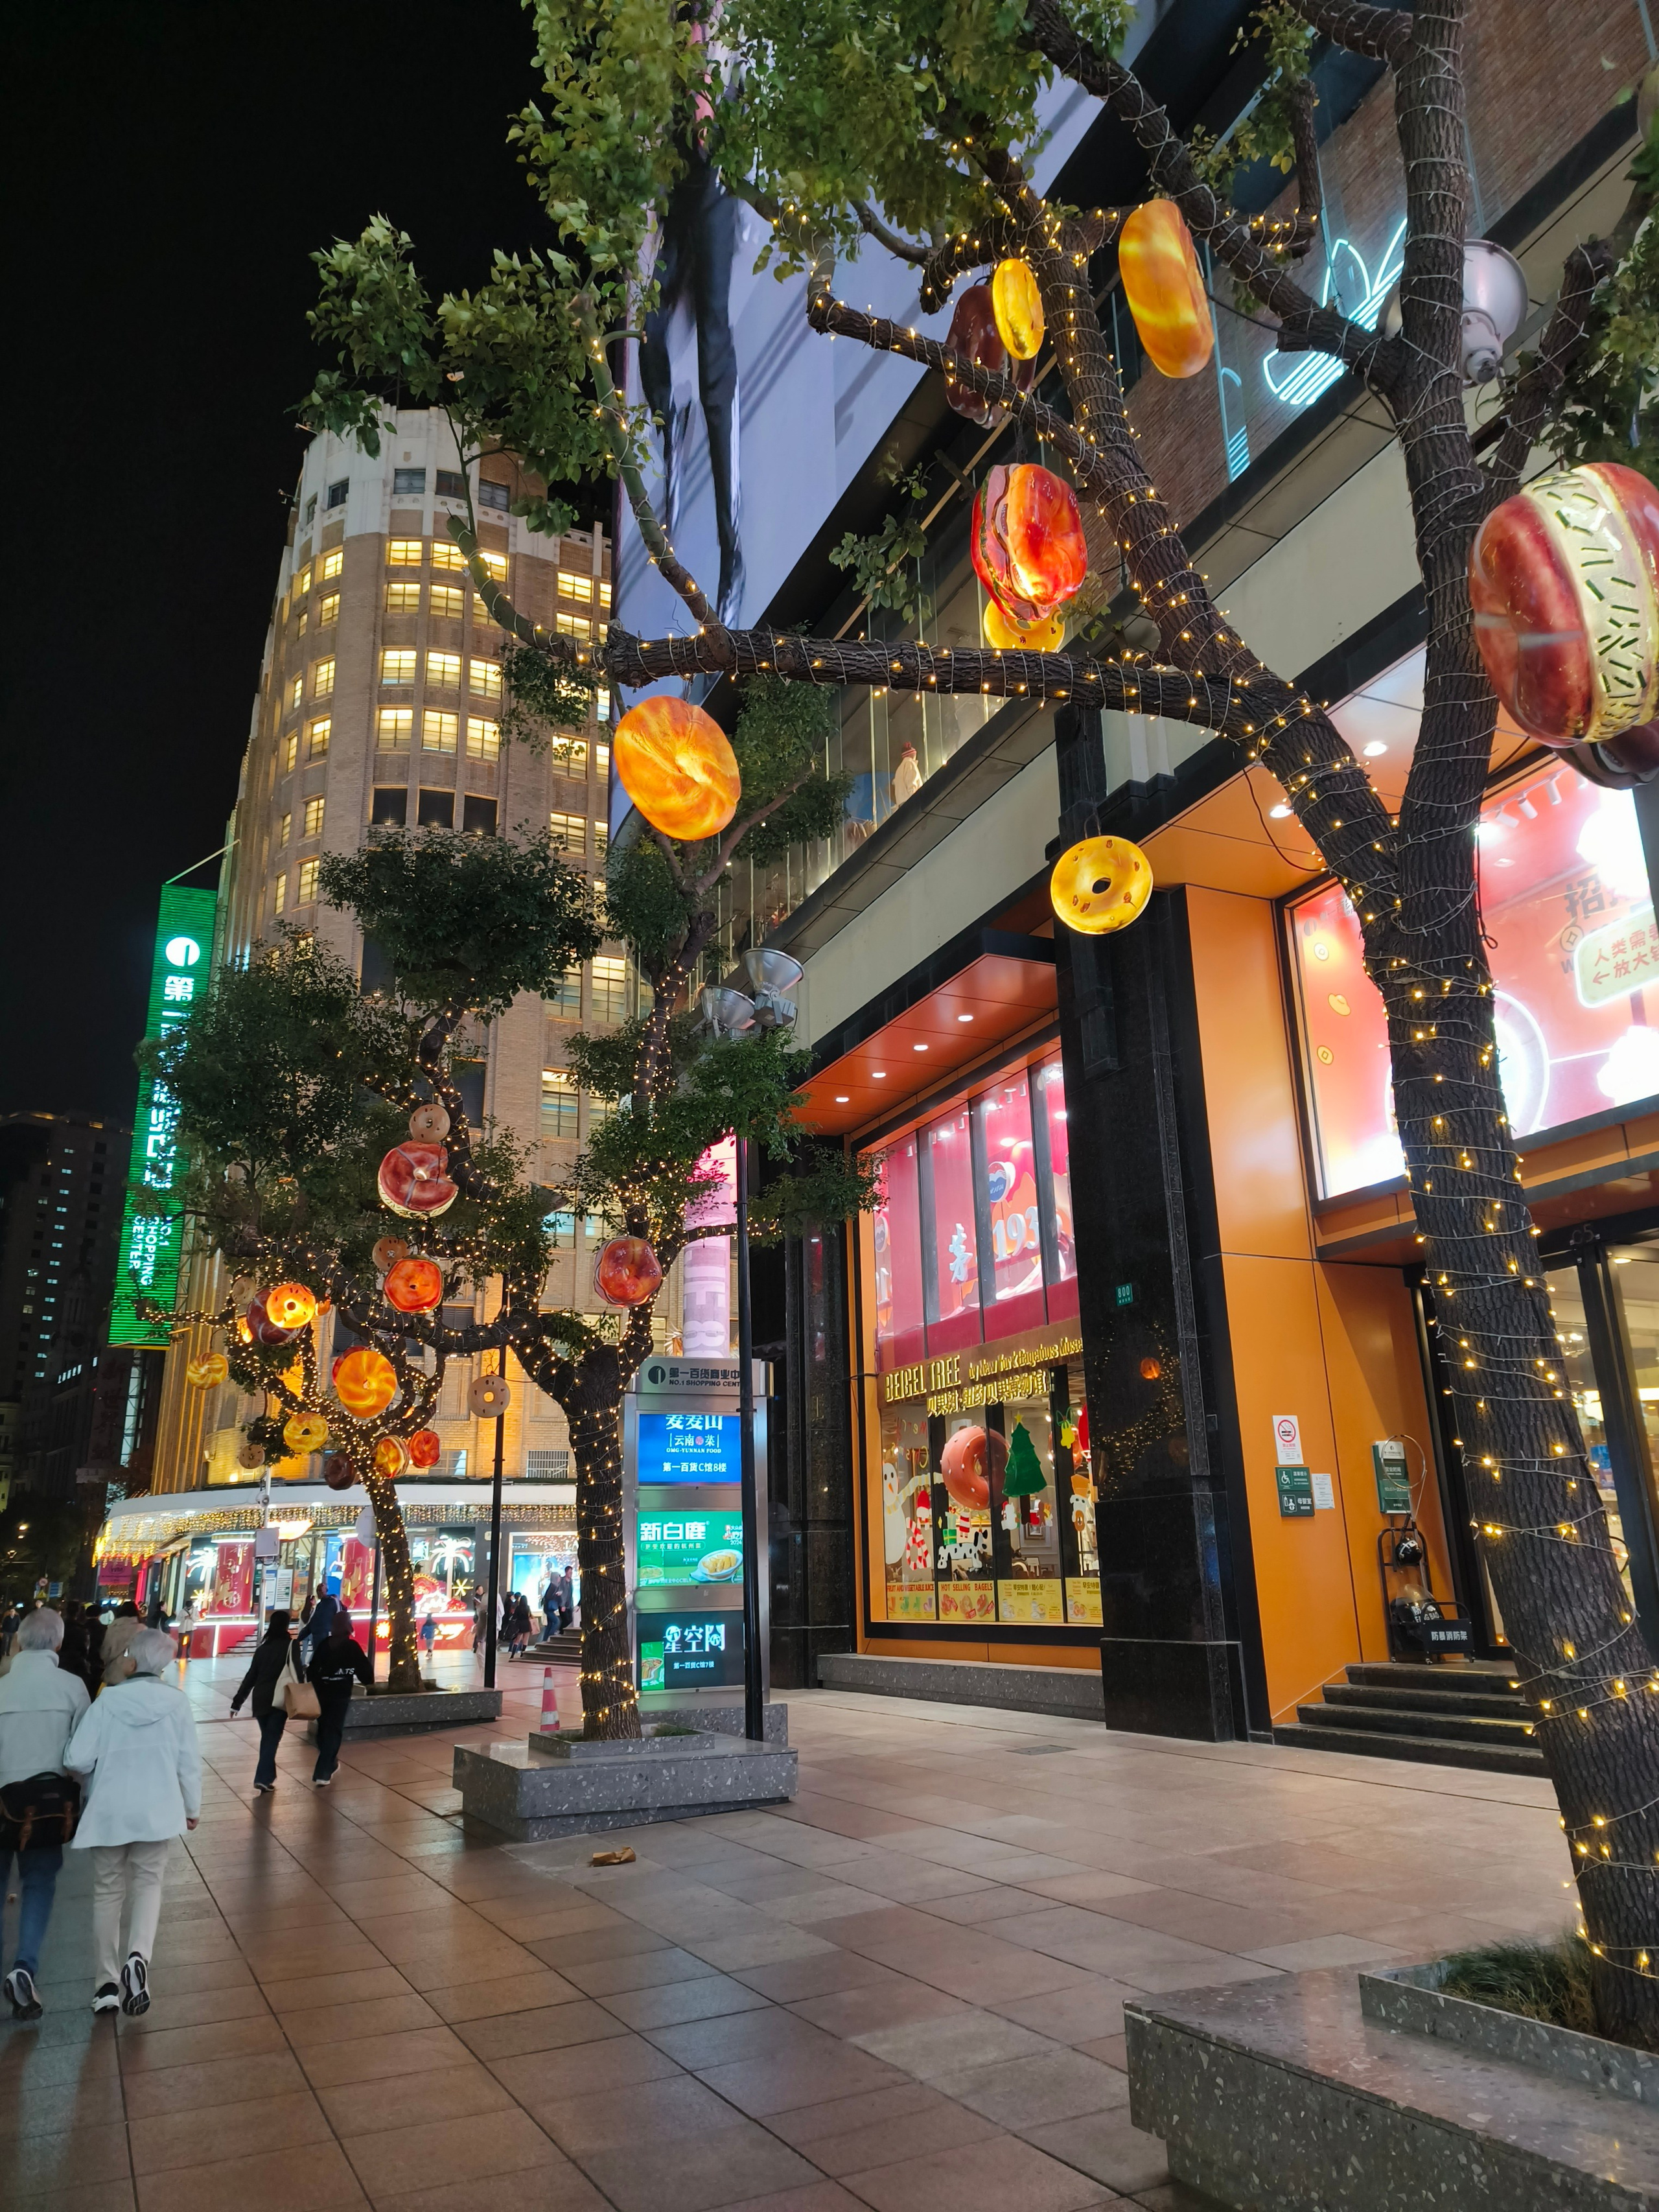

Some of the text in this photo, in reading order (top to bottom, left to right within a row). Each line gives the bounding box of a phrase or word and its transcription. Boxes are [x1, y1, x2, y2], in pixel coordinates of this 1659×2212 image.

[1118, 1285, 1130, 1298] 800
[885, 1365, 927, 1403] BEIGEL
[929, 1355, 962, 1391] TREE
[662, 1461, 726, 1473] 第一百货C馆8楼
[640, 1522, 706, 1541] 新白鹿
[673, 1660, 715, 1670] 第一百货C馆7楼
